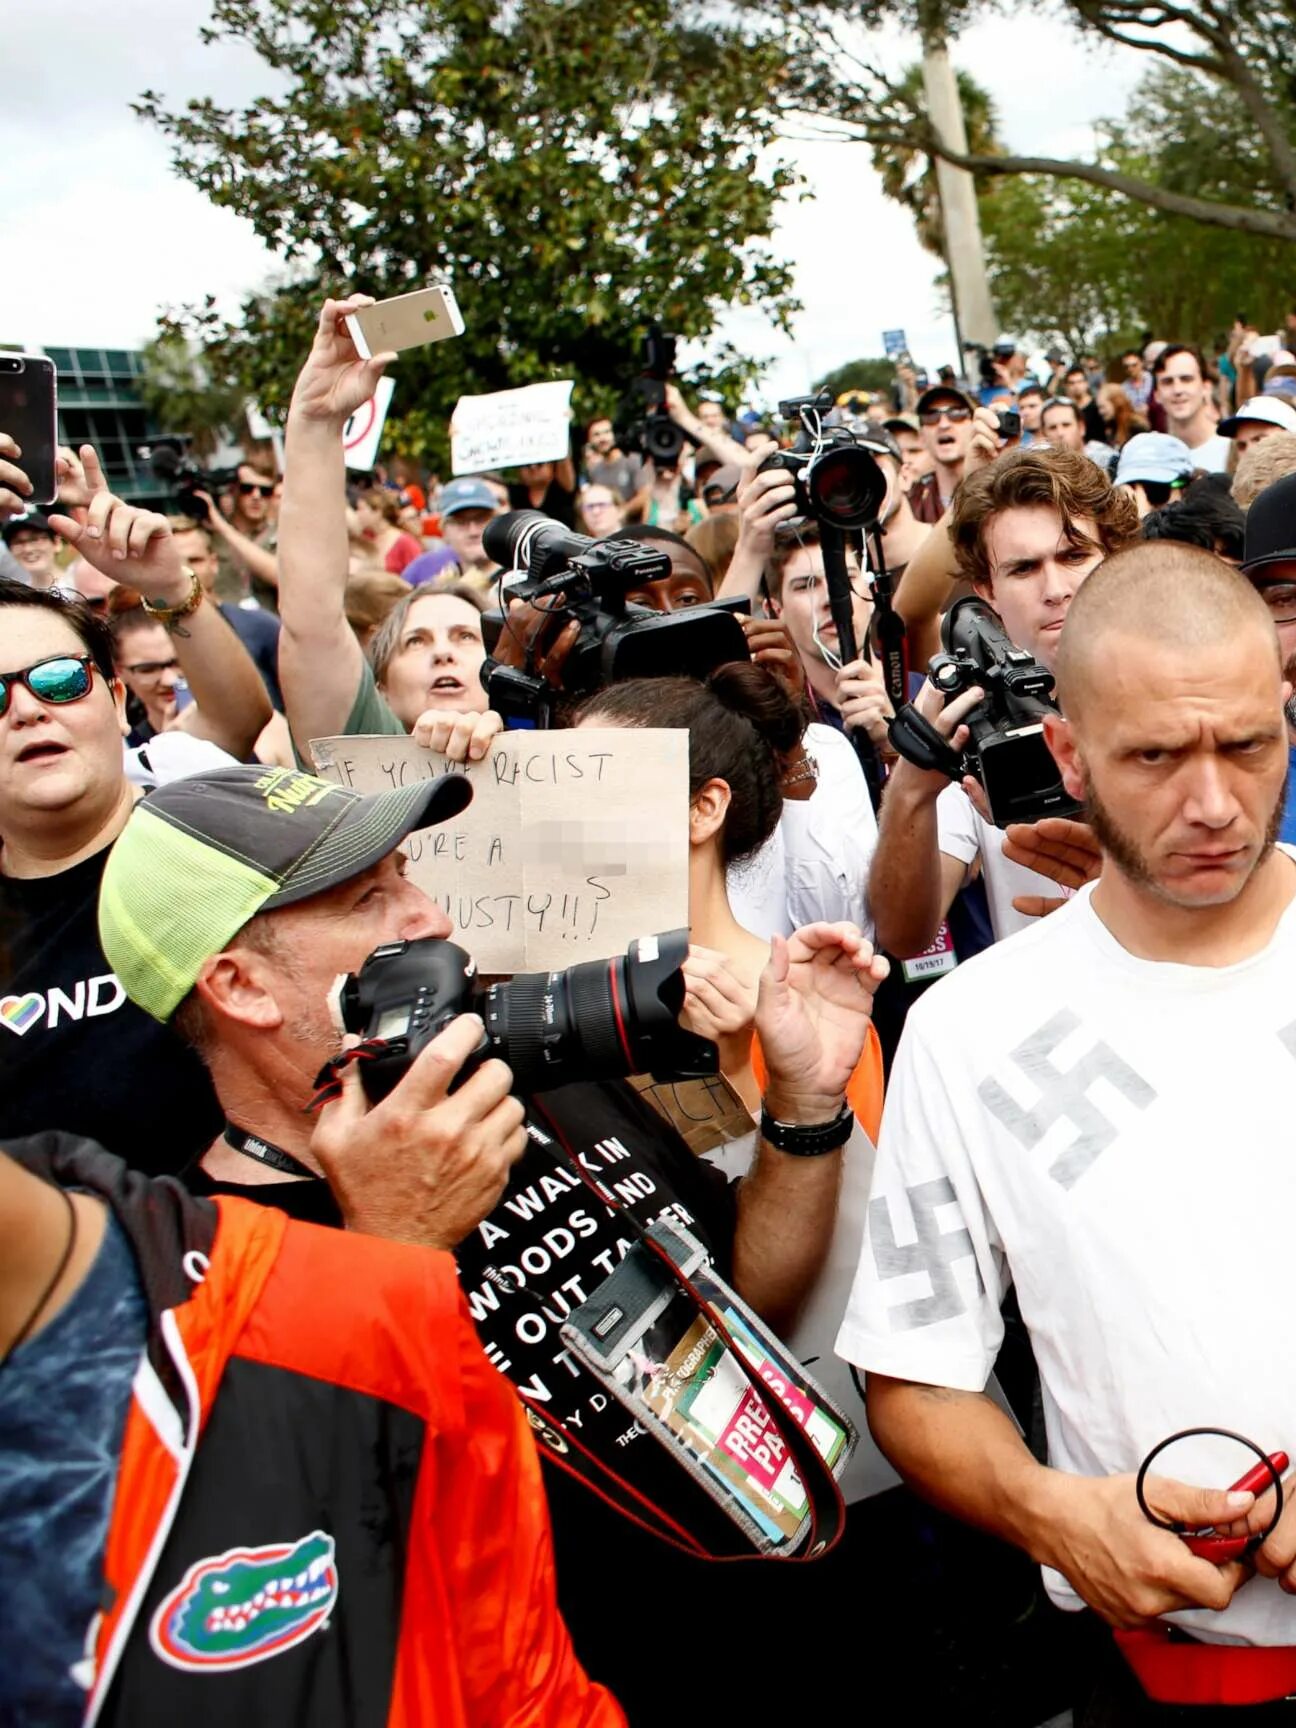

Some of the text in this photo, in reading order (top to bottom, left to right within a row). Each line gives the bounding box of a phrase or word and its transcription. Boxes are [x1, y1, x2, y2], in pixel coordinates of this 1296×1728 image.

[493, 751, 614, 785] RACIST
[409, 832, 466, 862] U'RE
[488, 837, 503, 867] A
[478, 1219, 511, 1250] A
[503, 1151, 604, 1221] WALK
[594, 1136, 632, 1164] IN
[469, 1209, 599, 1322] WOODS
[515, 1273, 589, 1345] OUT
[724, 1369, 786, 1462] PRES
[750, 1397, 805, 1476] PAS
